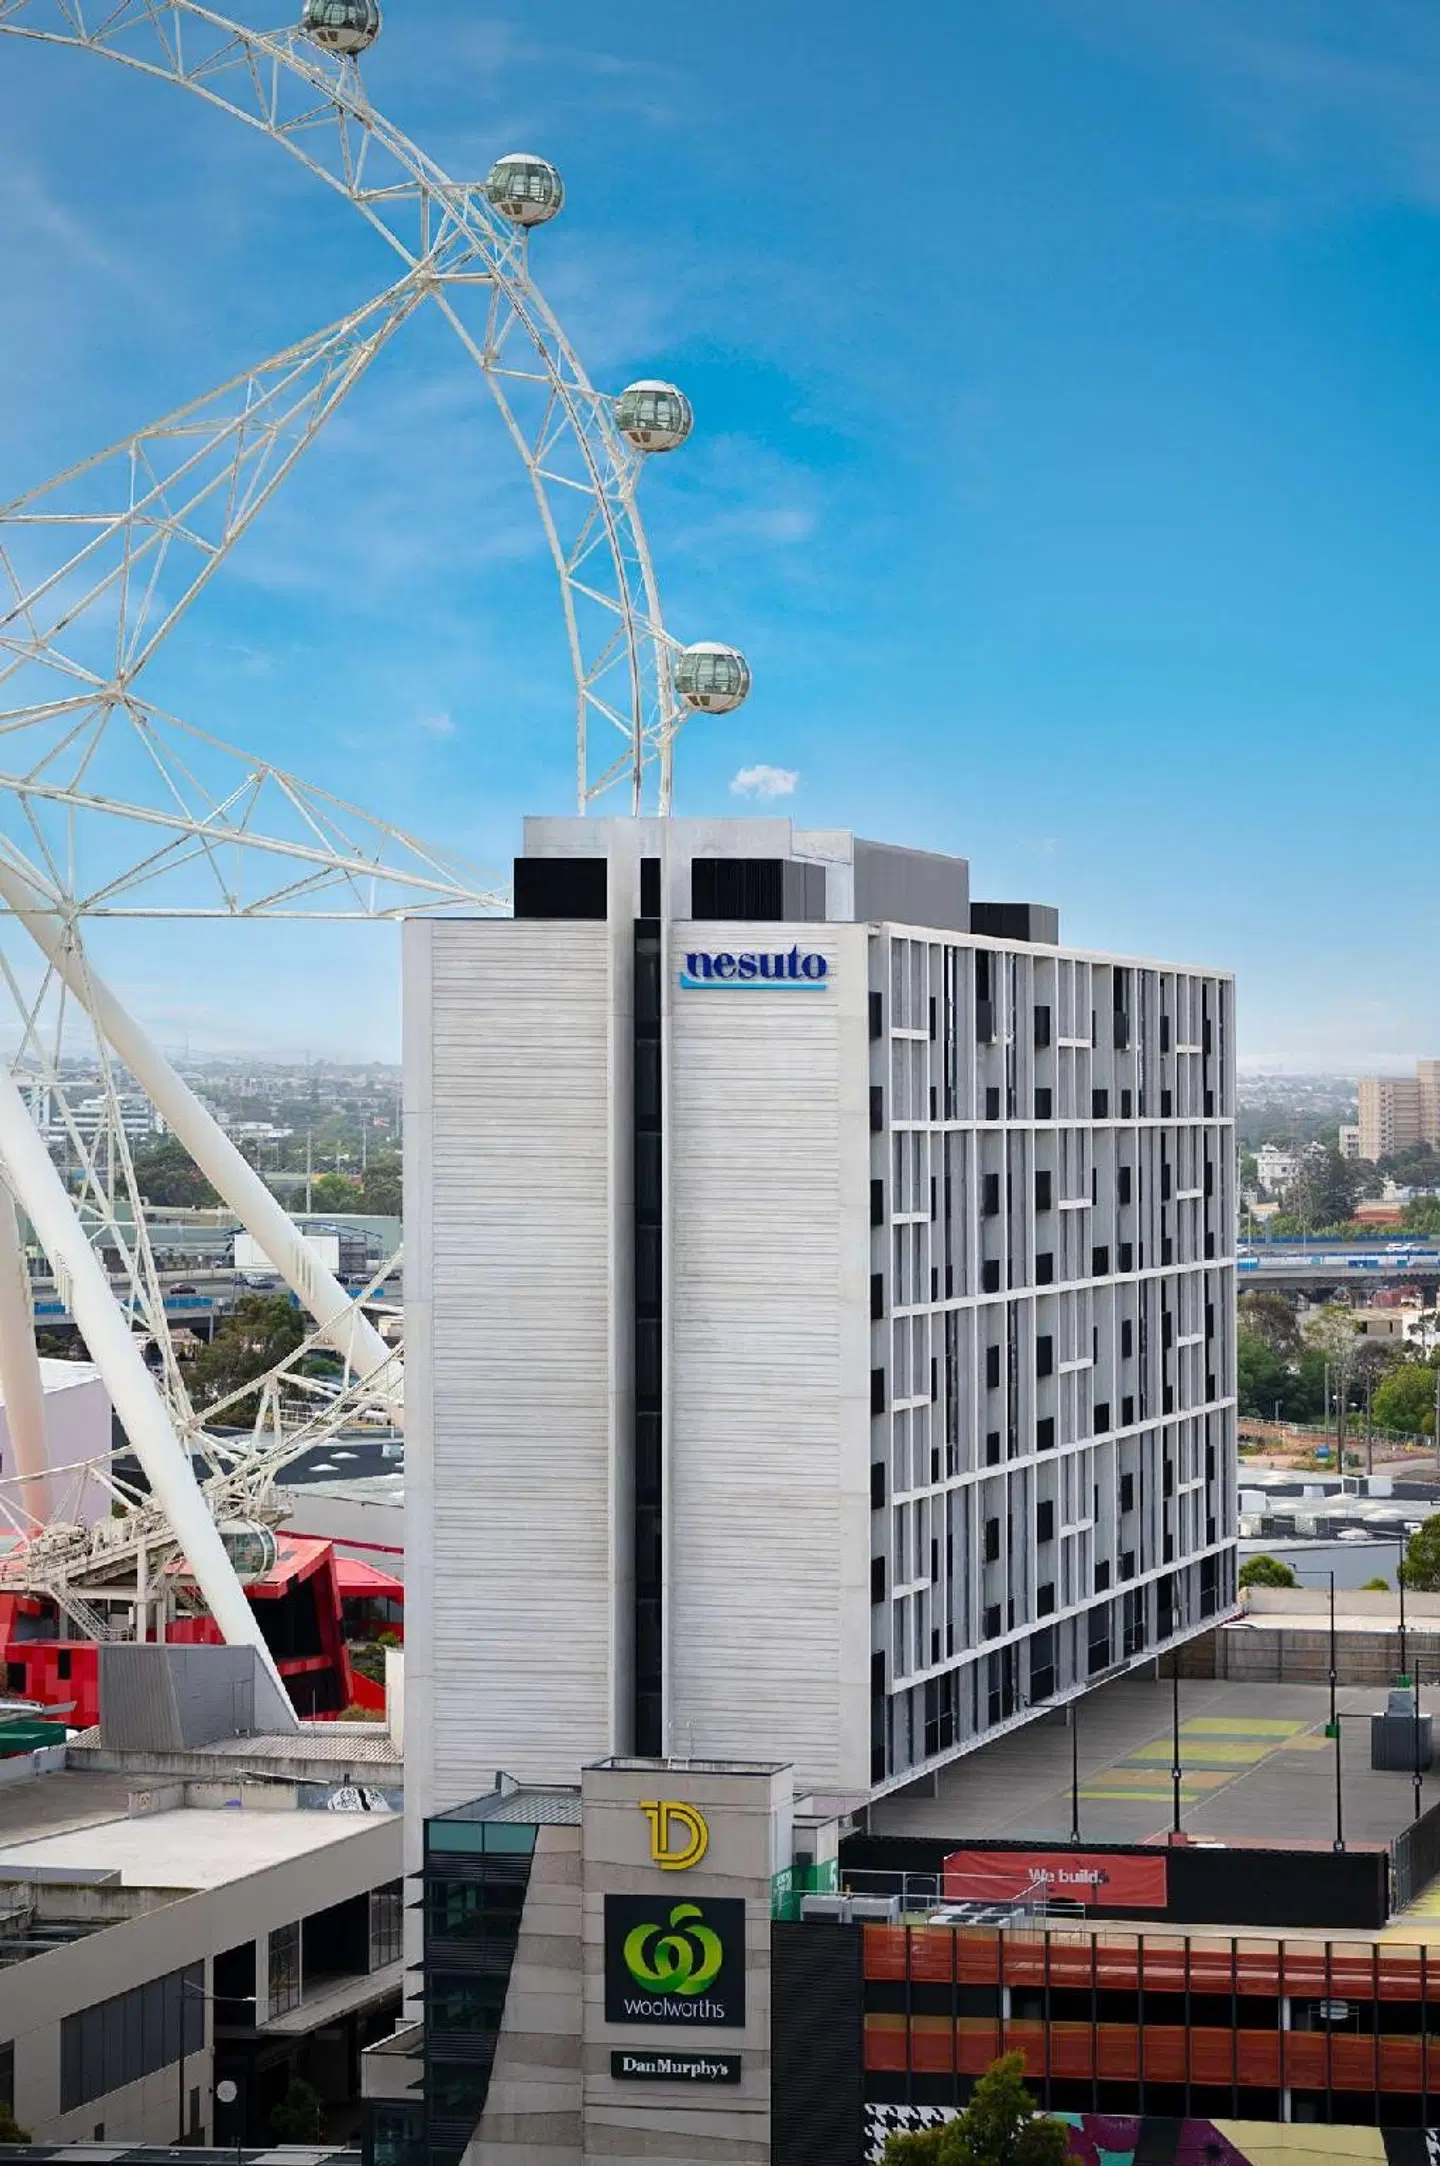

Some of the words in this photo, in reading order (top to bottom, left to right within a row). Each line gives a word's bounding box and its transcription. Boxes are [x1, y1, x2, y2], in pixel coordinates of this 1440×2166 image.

[685, 944, 828, 979] nesuto
[1028, 1867, 1055, 1883] We
[624, 1997, 725, 2018] woolworths
